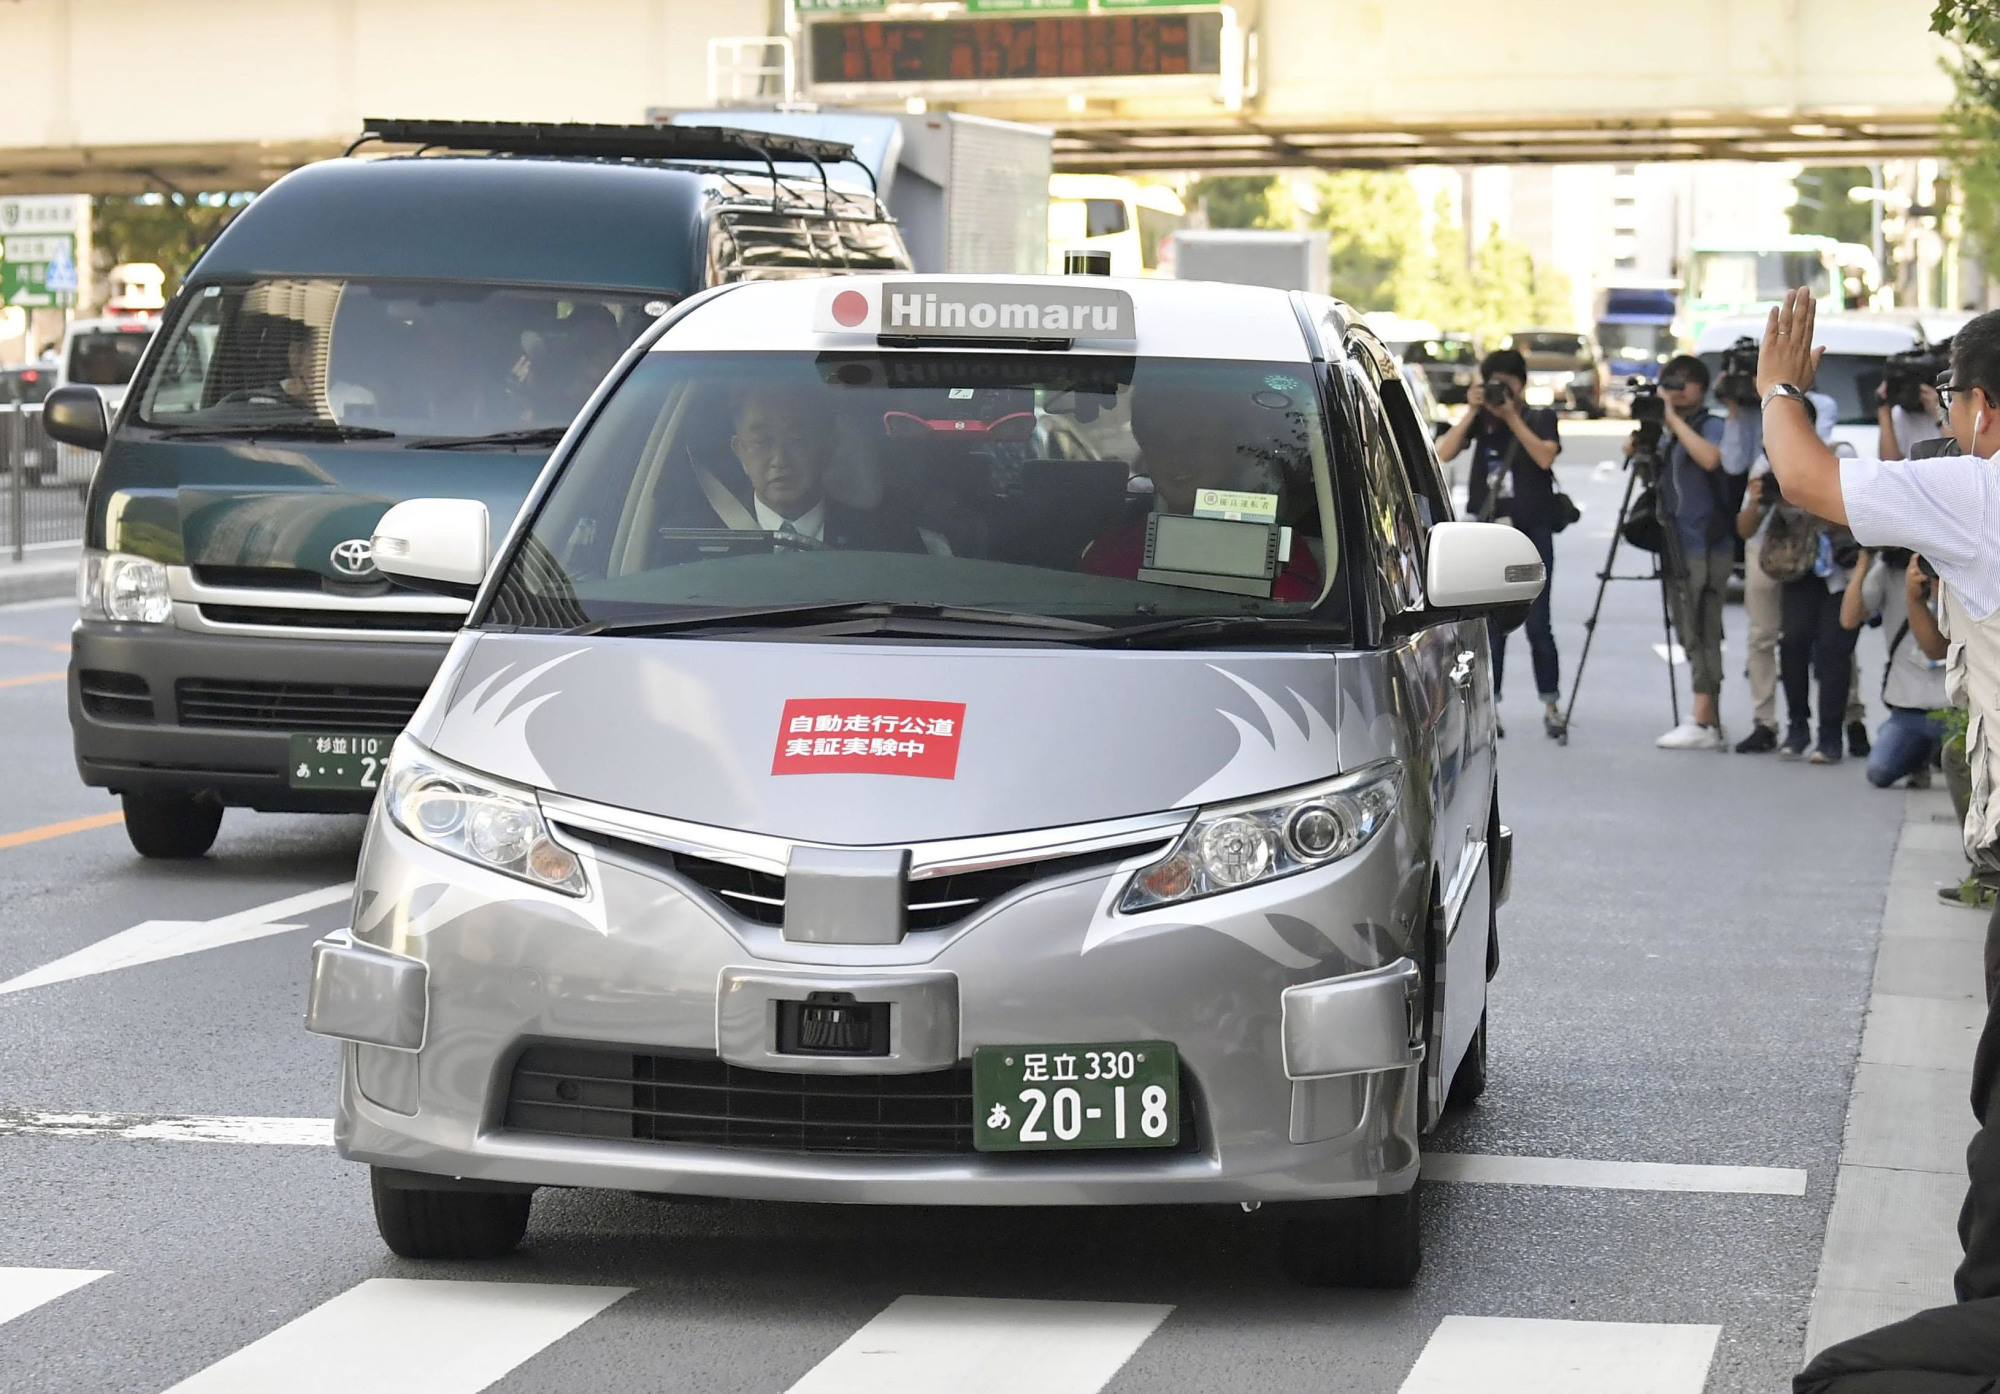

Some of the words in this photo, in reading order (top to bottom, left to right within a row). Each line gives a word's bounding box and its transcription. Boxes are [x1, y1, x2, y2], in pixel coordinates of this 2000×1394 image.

[891, 293, 1118, 331] Hinomaru
[789, 713, 955, 737] 自動走行公道
[785, 737, 925, 758] 実証実験中
[986, 1102, 1011, 1130] あ
[1018, 1085, 1168, 1142] 20-18
